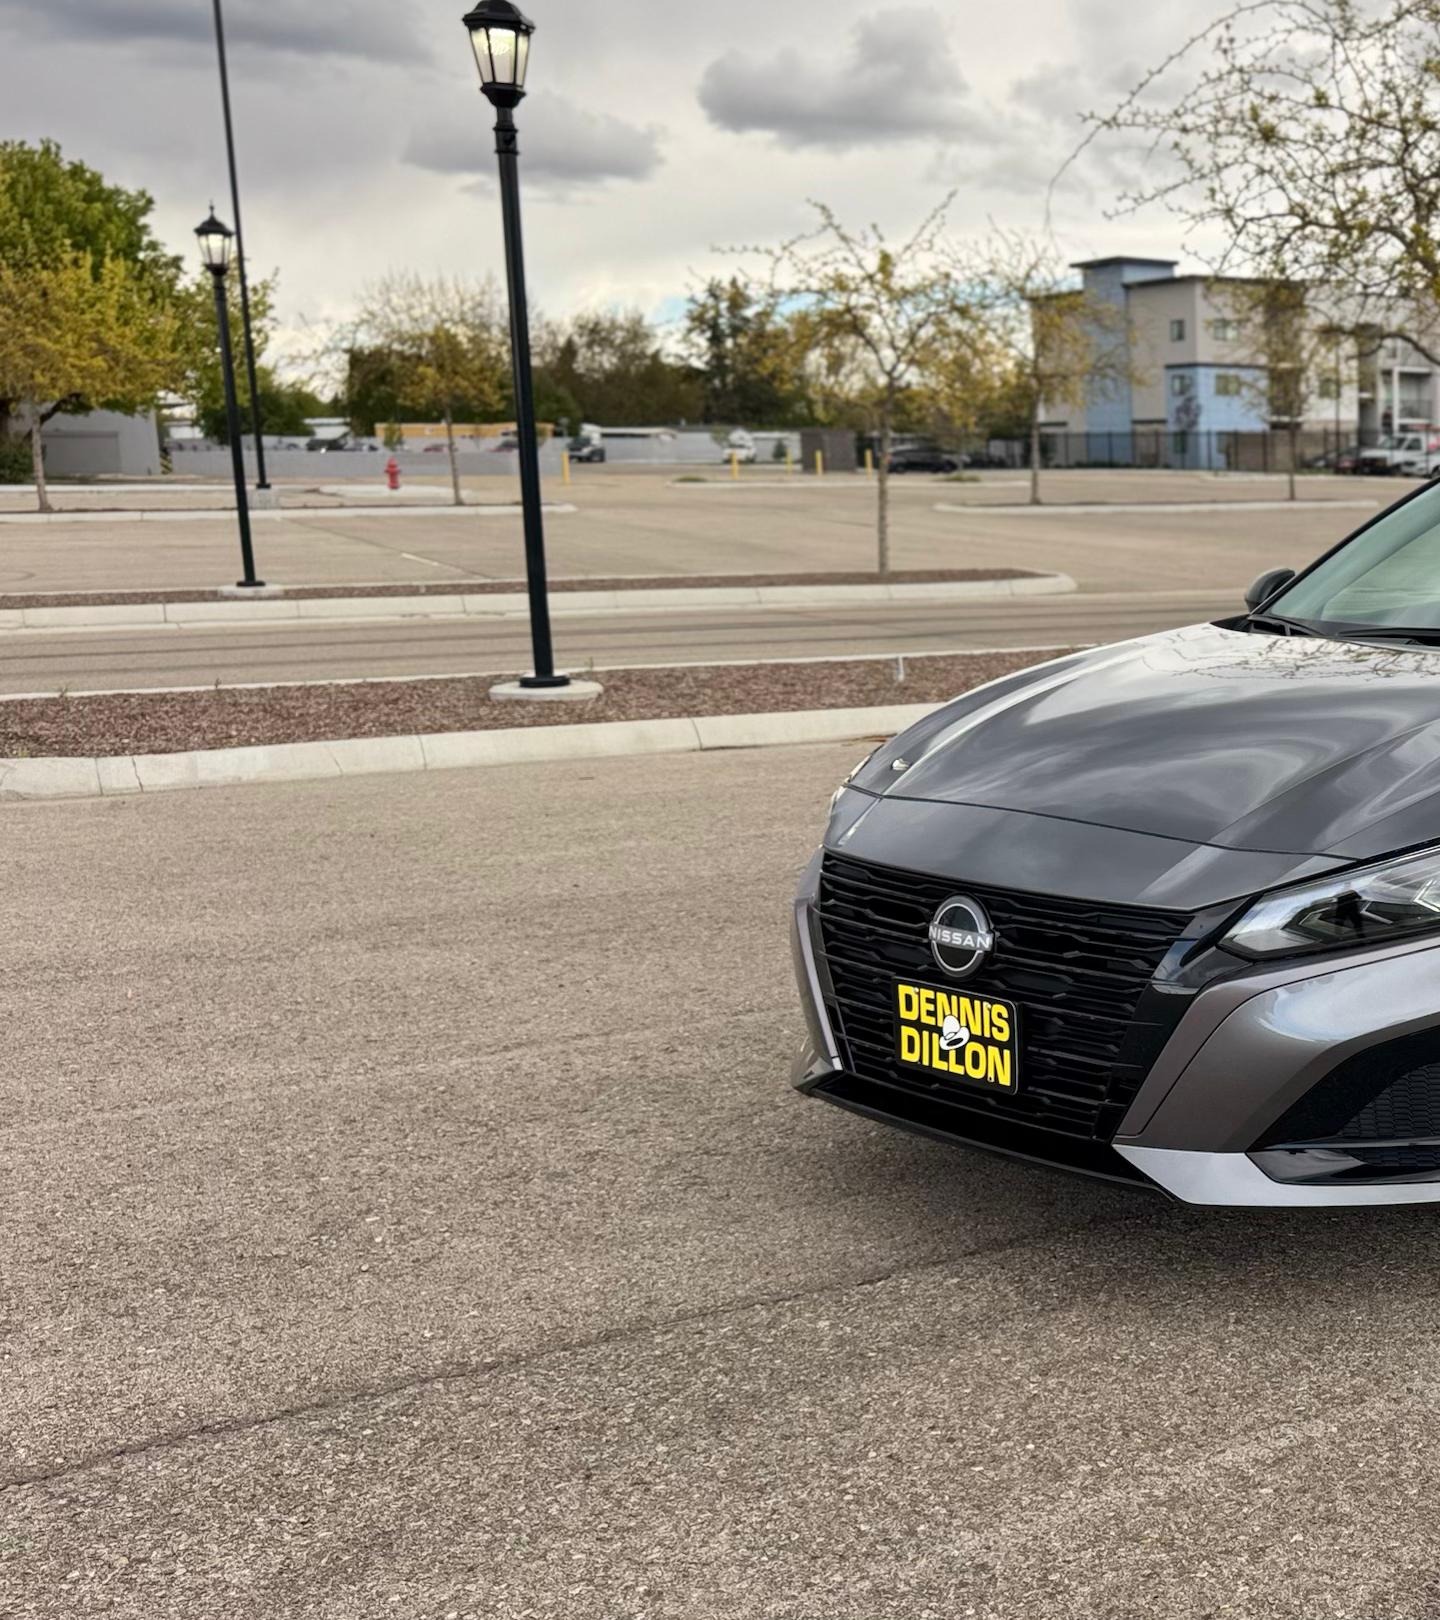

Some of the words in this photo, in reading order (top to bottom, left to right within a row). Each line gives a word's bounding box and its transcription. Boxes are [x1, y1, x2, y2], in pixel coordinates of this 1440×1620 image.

[929, 926, 991, 949] NISSAN
[898, 984, 1011, 1042] DENNIS
[901, 1025, 1011, 1087] DILLON
